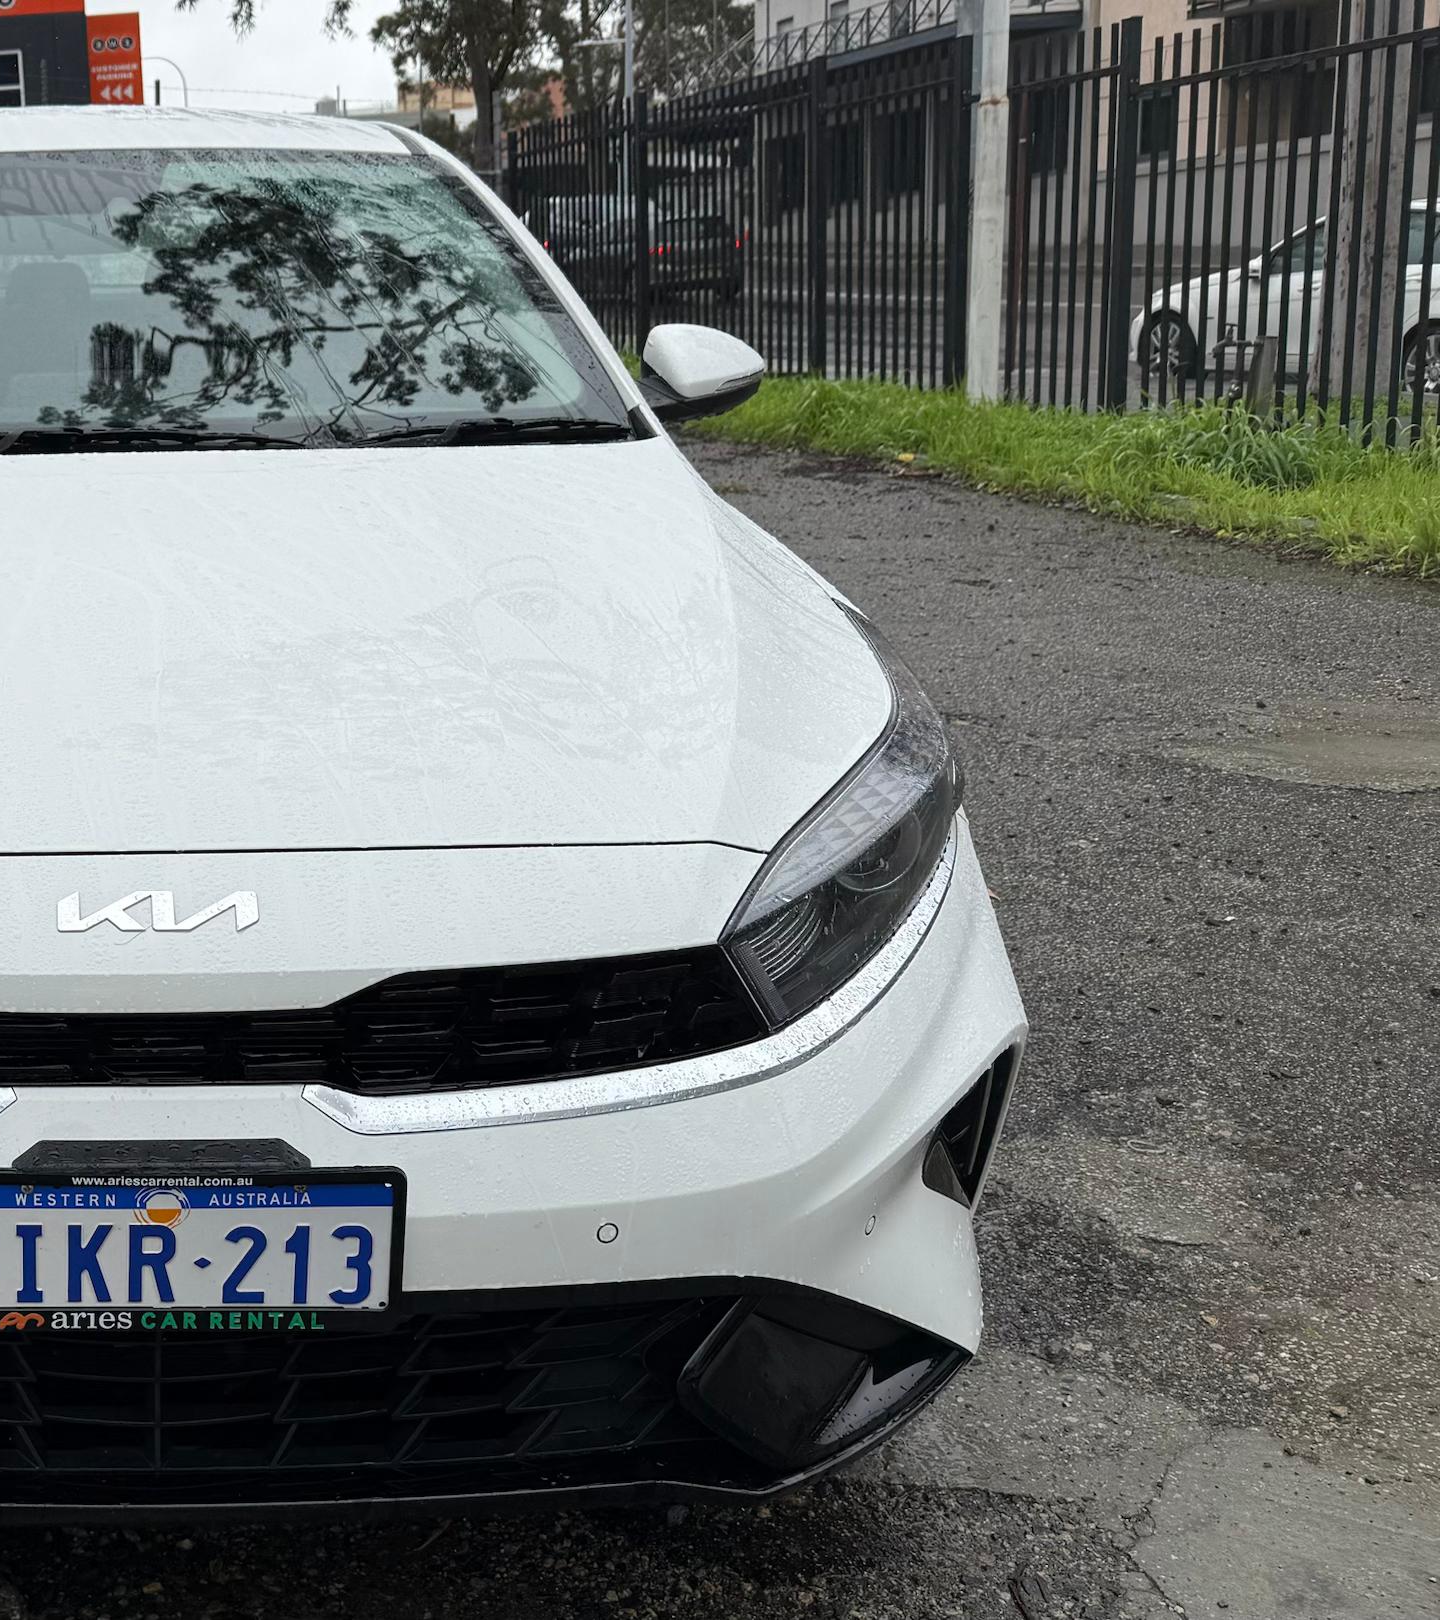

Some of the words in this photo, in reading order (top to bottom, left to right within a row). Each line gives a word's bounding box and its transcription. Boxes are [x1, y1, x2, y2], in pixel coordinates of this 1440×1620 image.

[57, 890, 259, 932] KIA
[71, 1175, 253, 1187] www.ariescarrental.com.au
[15, 1193, 116, 1207] WESTERN
[209, 1191, 312, 1206] AUSTRALIA
[50, 1311, 133, 1330] aries
[140, 1311, 198, 1330] CAR
[209, 1311, 326, 1330] RENTAL
